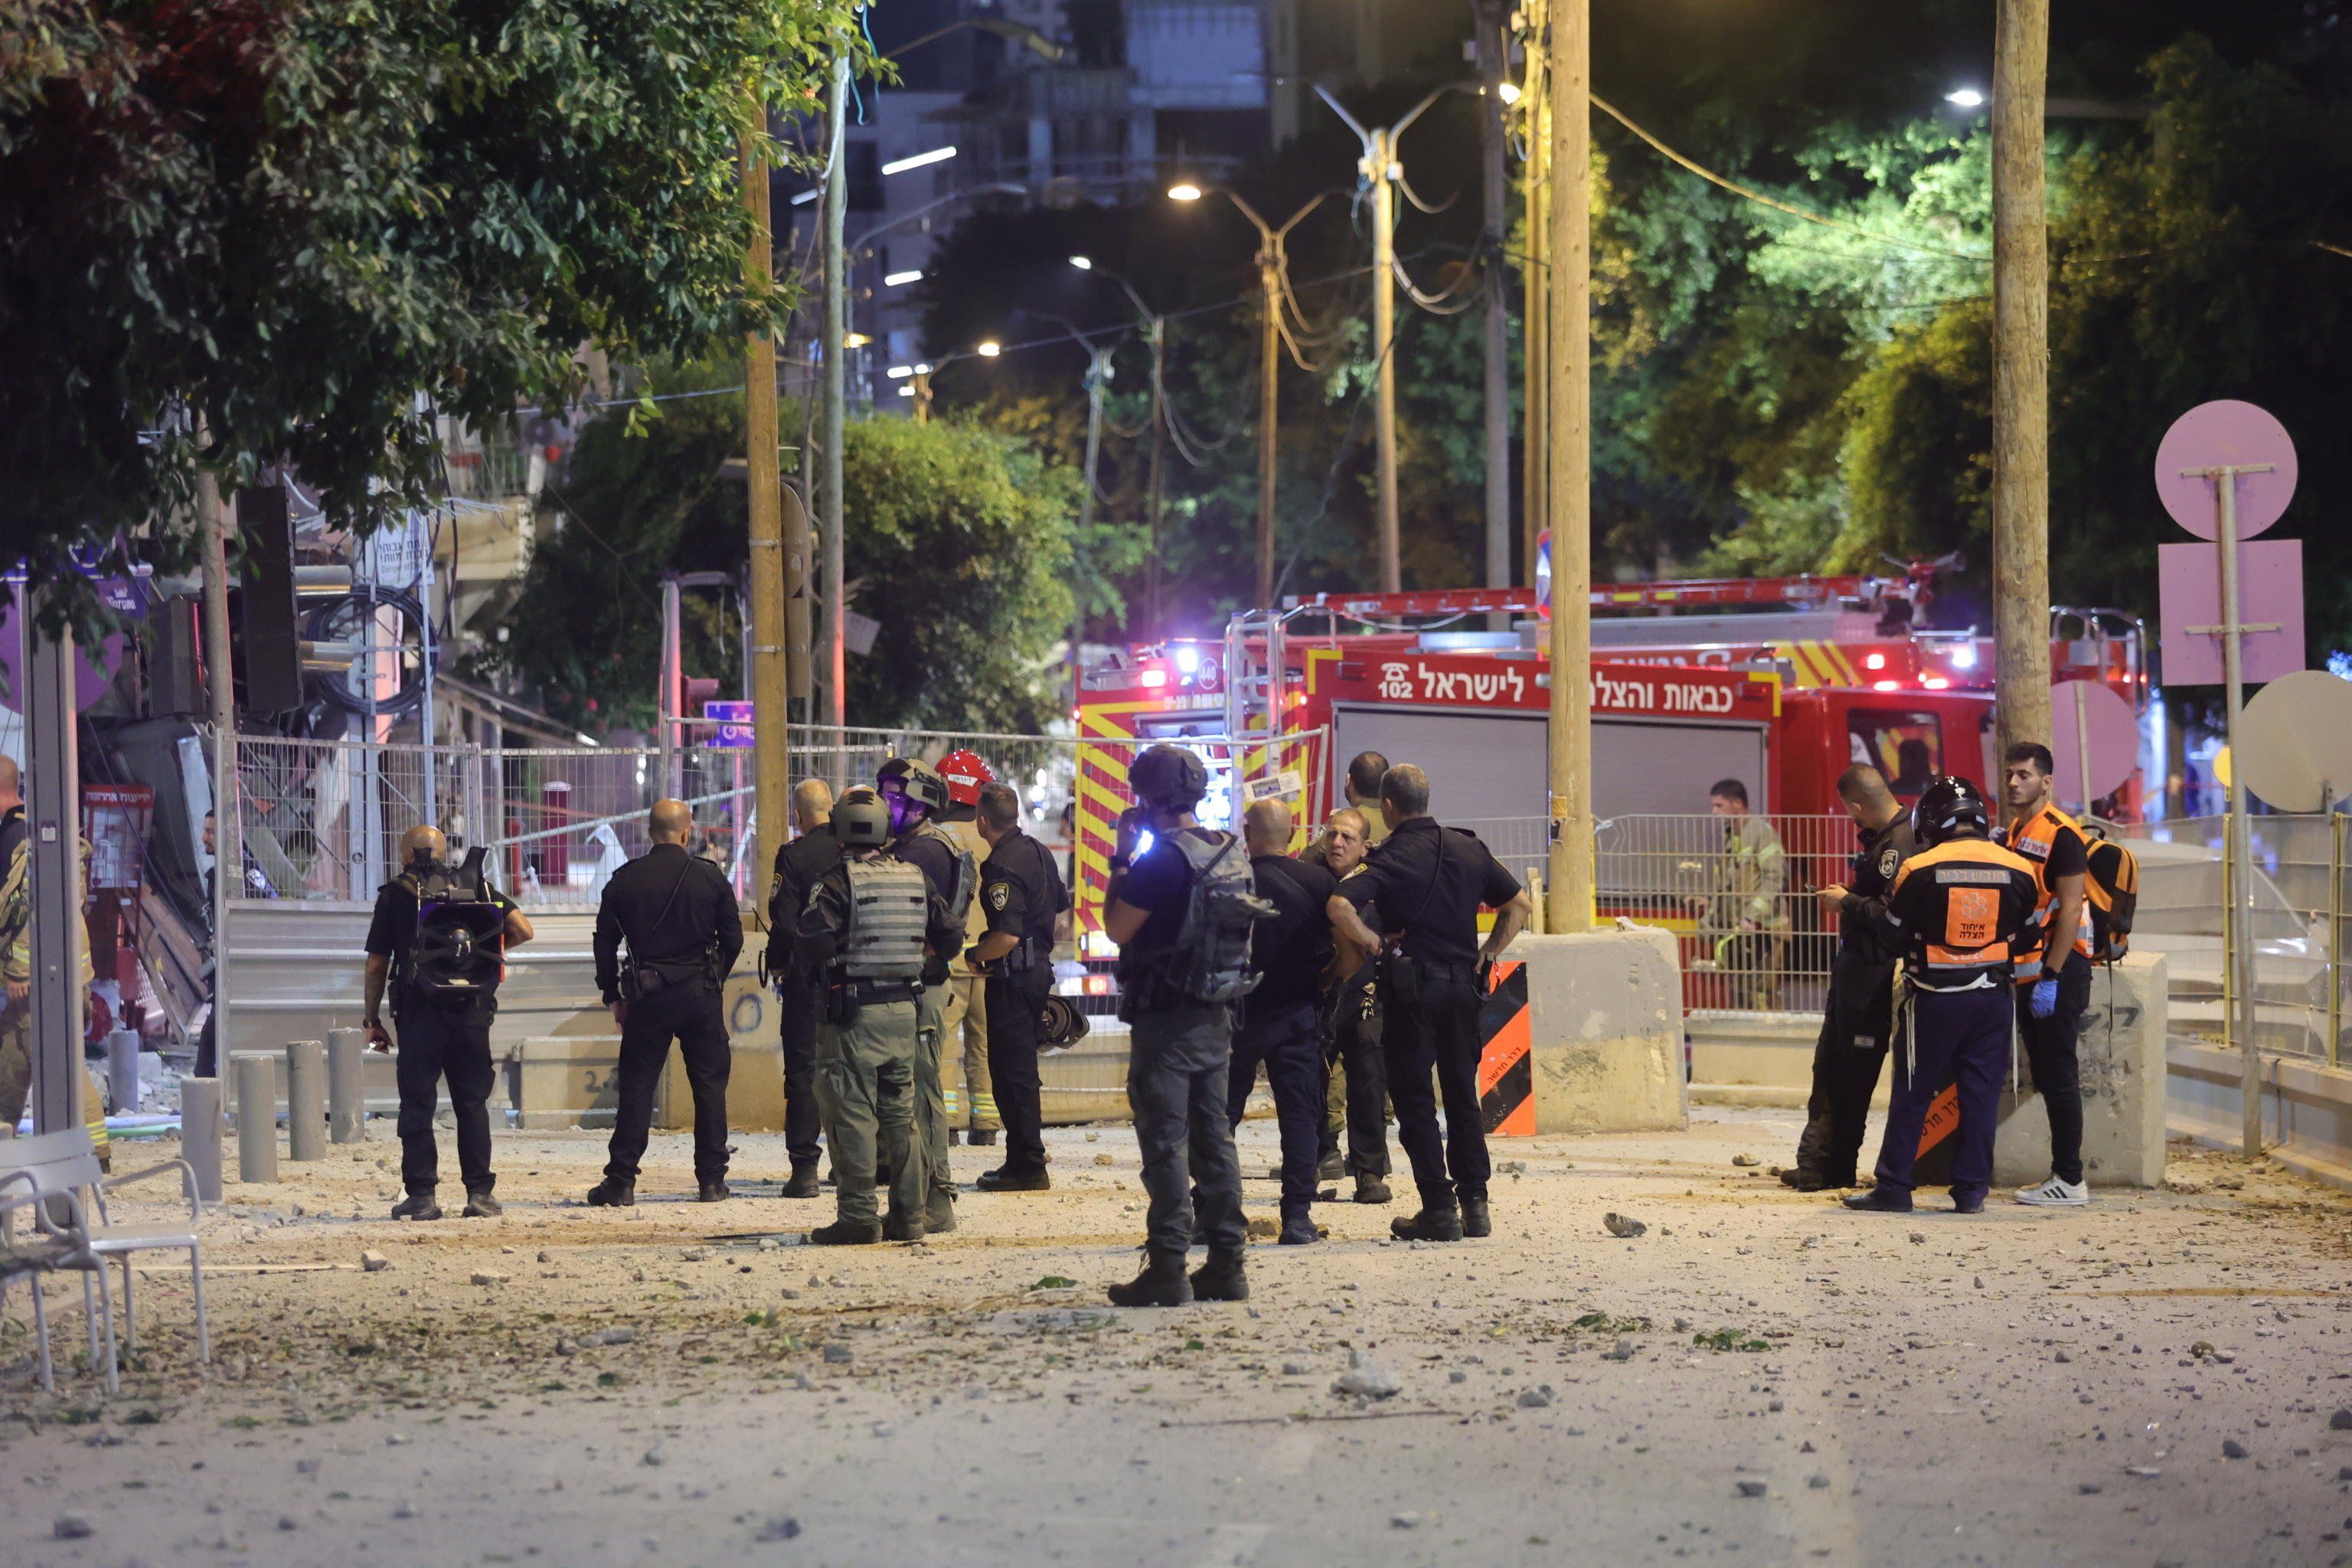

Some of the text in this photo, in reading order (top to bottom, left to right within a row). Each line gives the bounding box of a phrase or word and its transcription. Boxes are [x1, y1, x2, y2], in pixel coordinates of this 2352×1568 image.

[1378, 681, 1413, 699] 102
[1418, 662, 1524, 703] לישראל
[1663, 684, 1733, 713] כבאות
[1959, 931, 1984, 939] הצלה
[1960, 923, 1985, 931] איחוד
